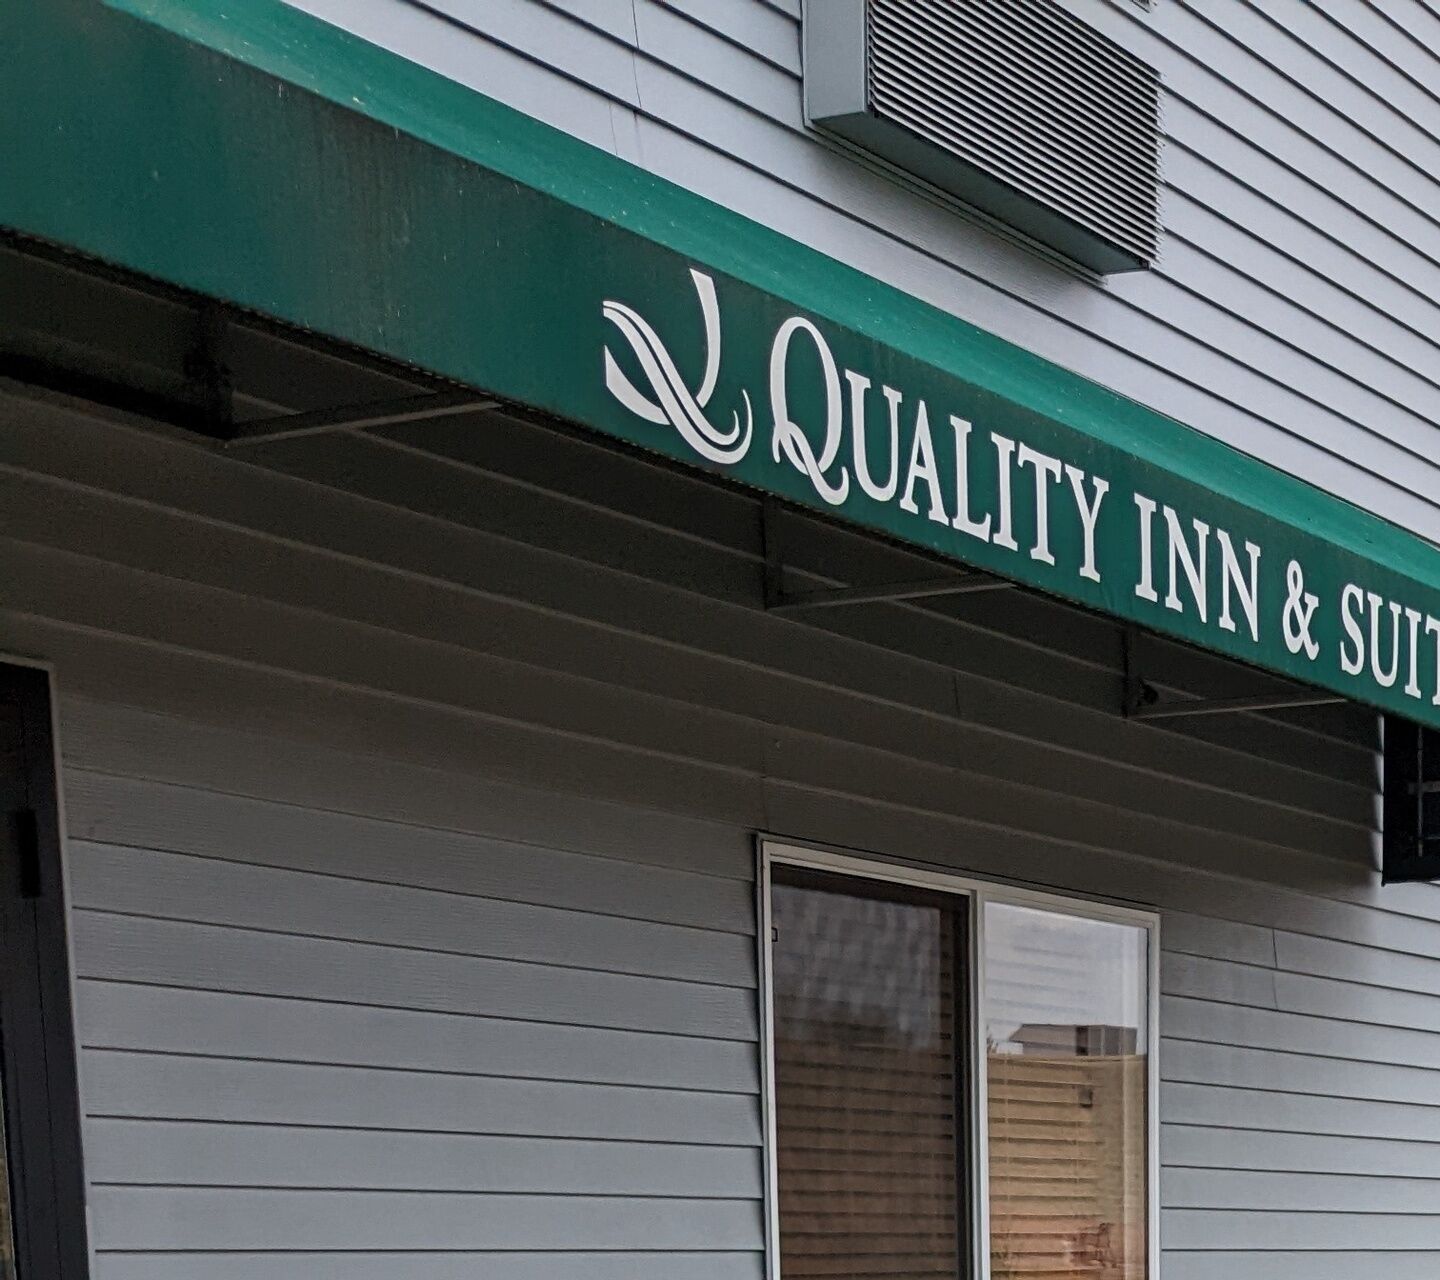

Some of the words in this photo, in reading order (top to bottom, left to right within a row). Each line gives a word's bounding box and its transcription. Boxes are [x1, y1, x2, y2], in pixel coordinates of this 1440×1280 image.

[769, 316, 1110, 584] QUALITY
[1133, 492, 1262, 643] INN
[1282, 559, 1320, 661] &
